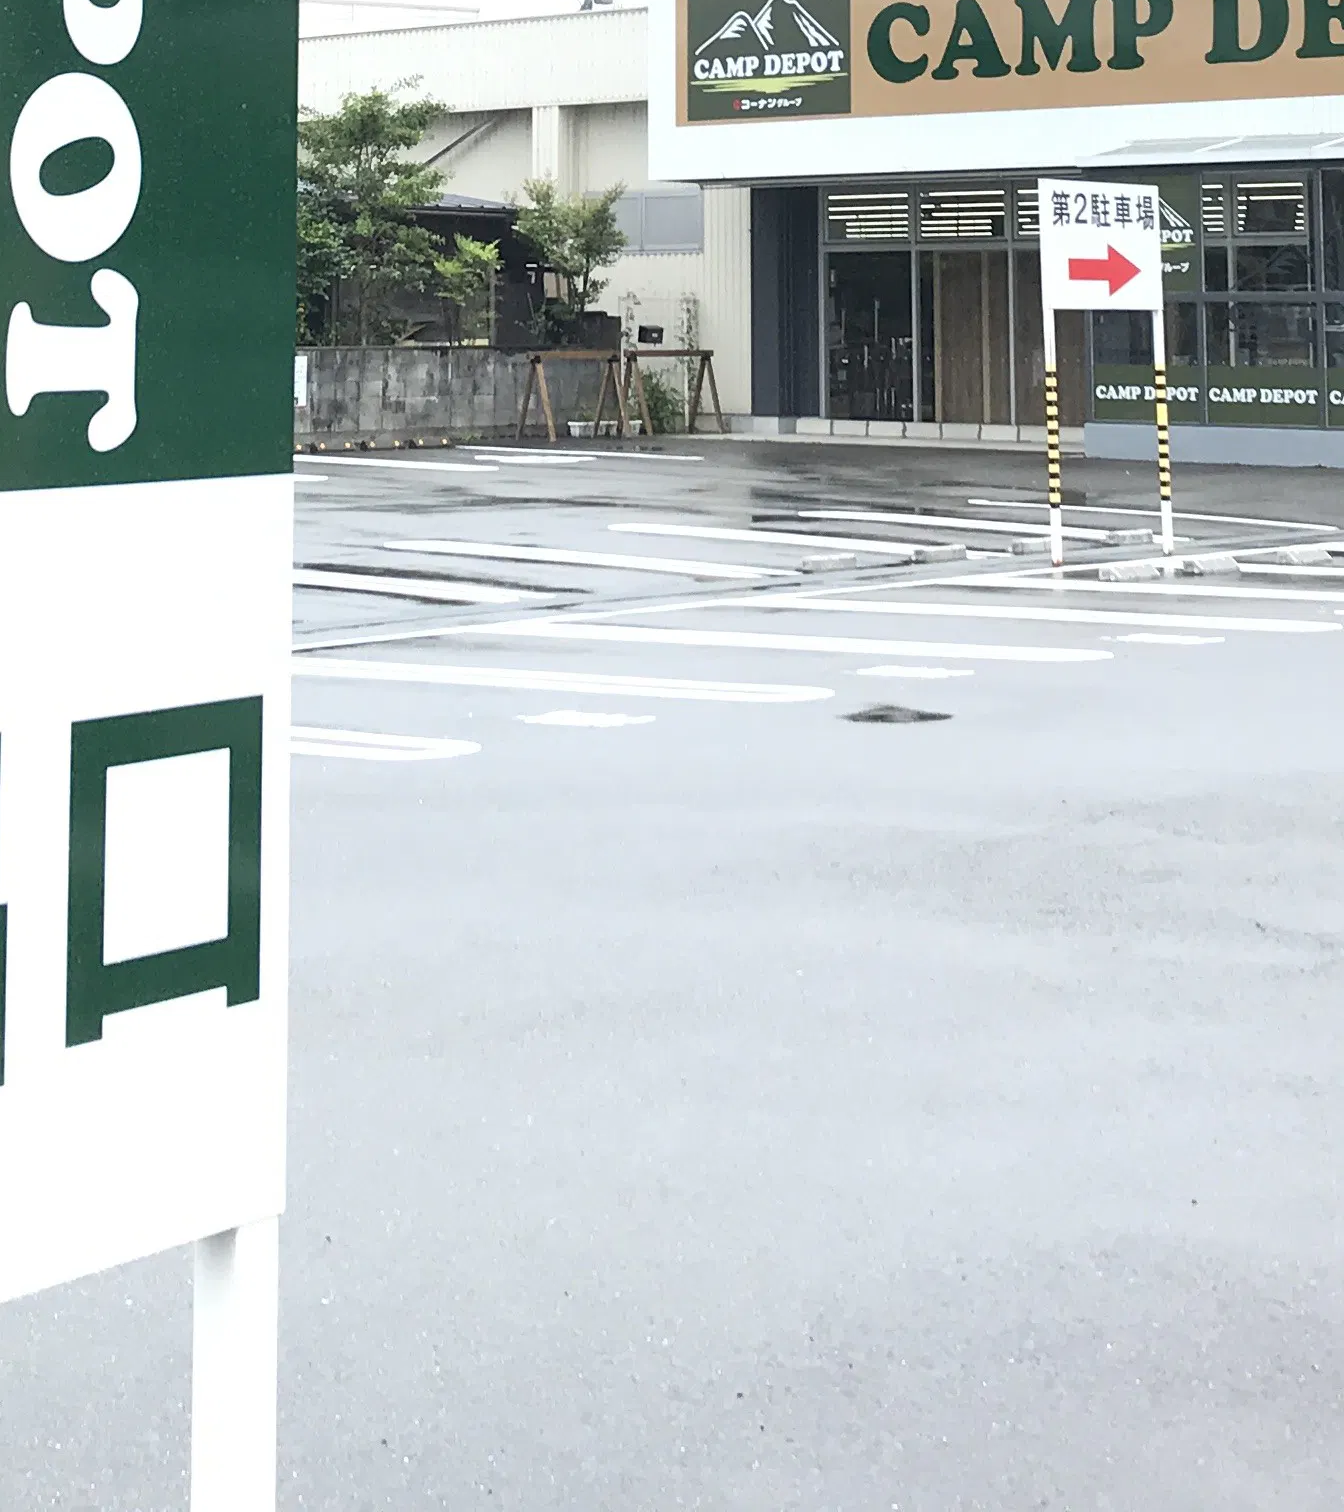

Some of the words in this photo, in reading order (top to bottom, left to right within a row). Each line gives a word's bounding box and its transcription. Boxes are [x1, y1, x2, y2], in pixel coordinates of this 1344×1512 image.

[693, 55, 759, 80] CAMP
[763, 50, 844, 76] DEPOT
[1051, 190, 1155, 230] 第2駐車場
[1096, 385, 1141, 400] CAMP
[1144, 387, 1199, 402] DPOT
[1209, 387, 1257, 403] CAMP
[1260, 388, 1318, 405] DEPOT
